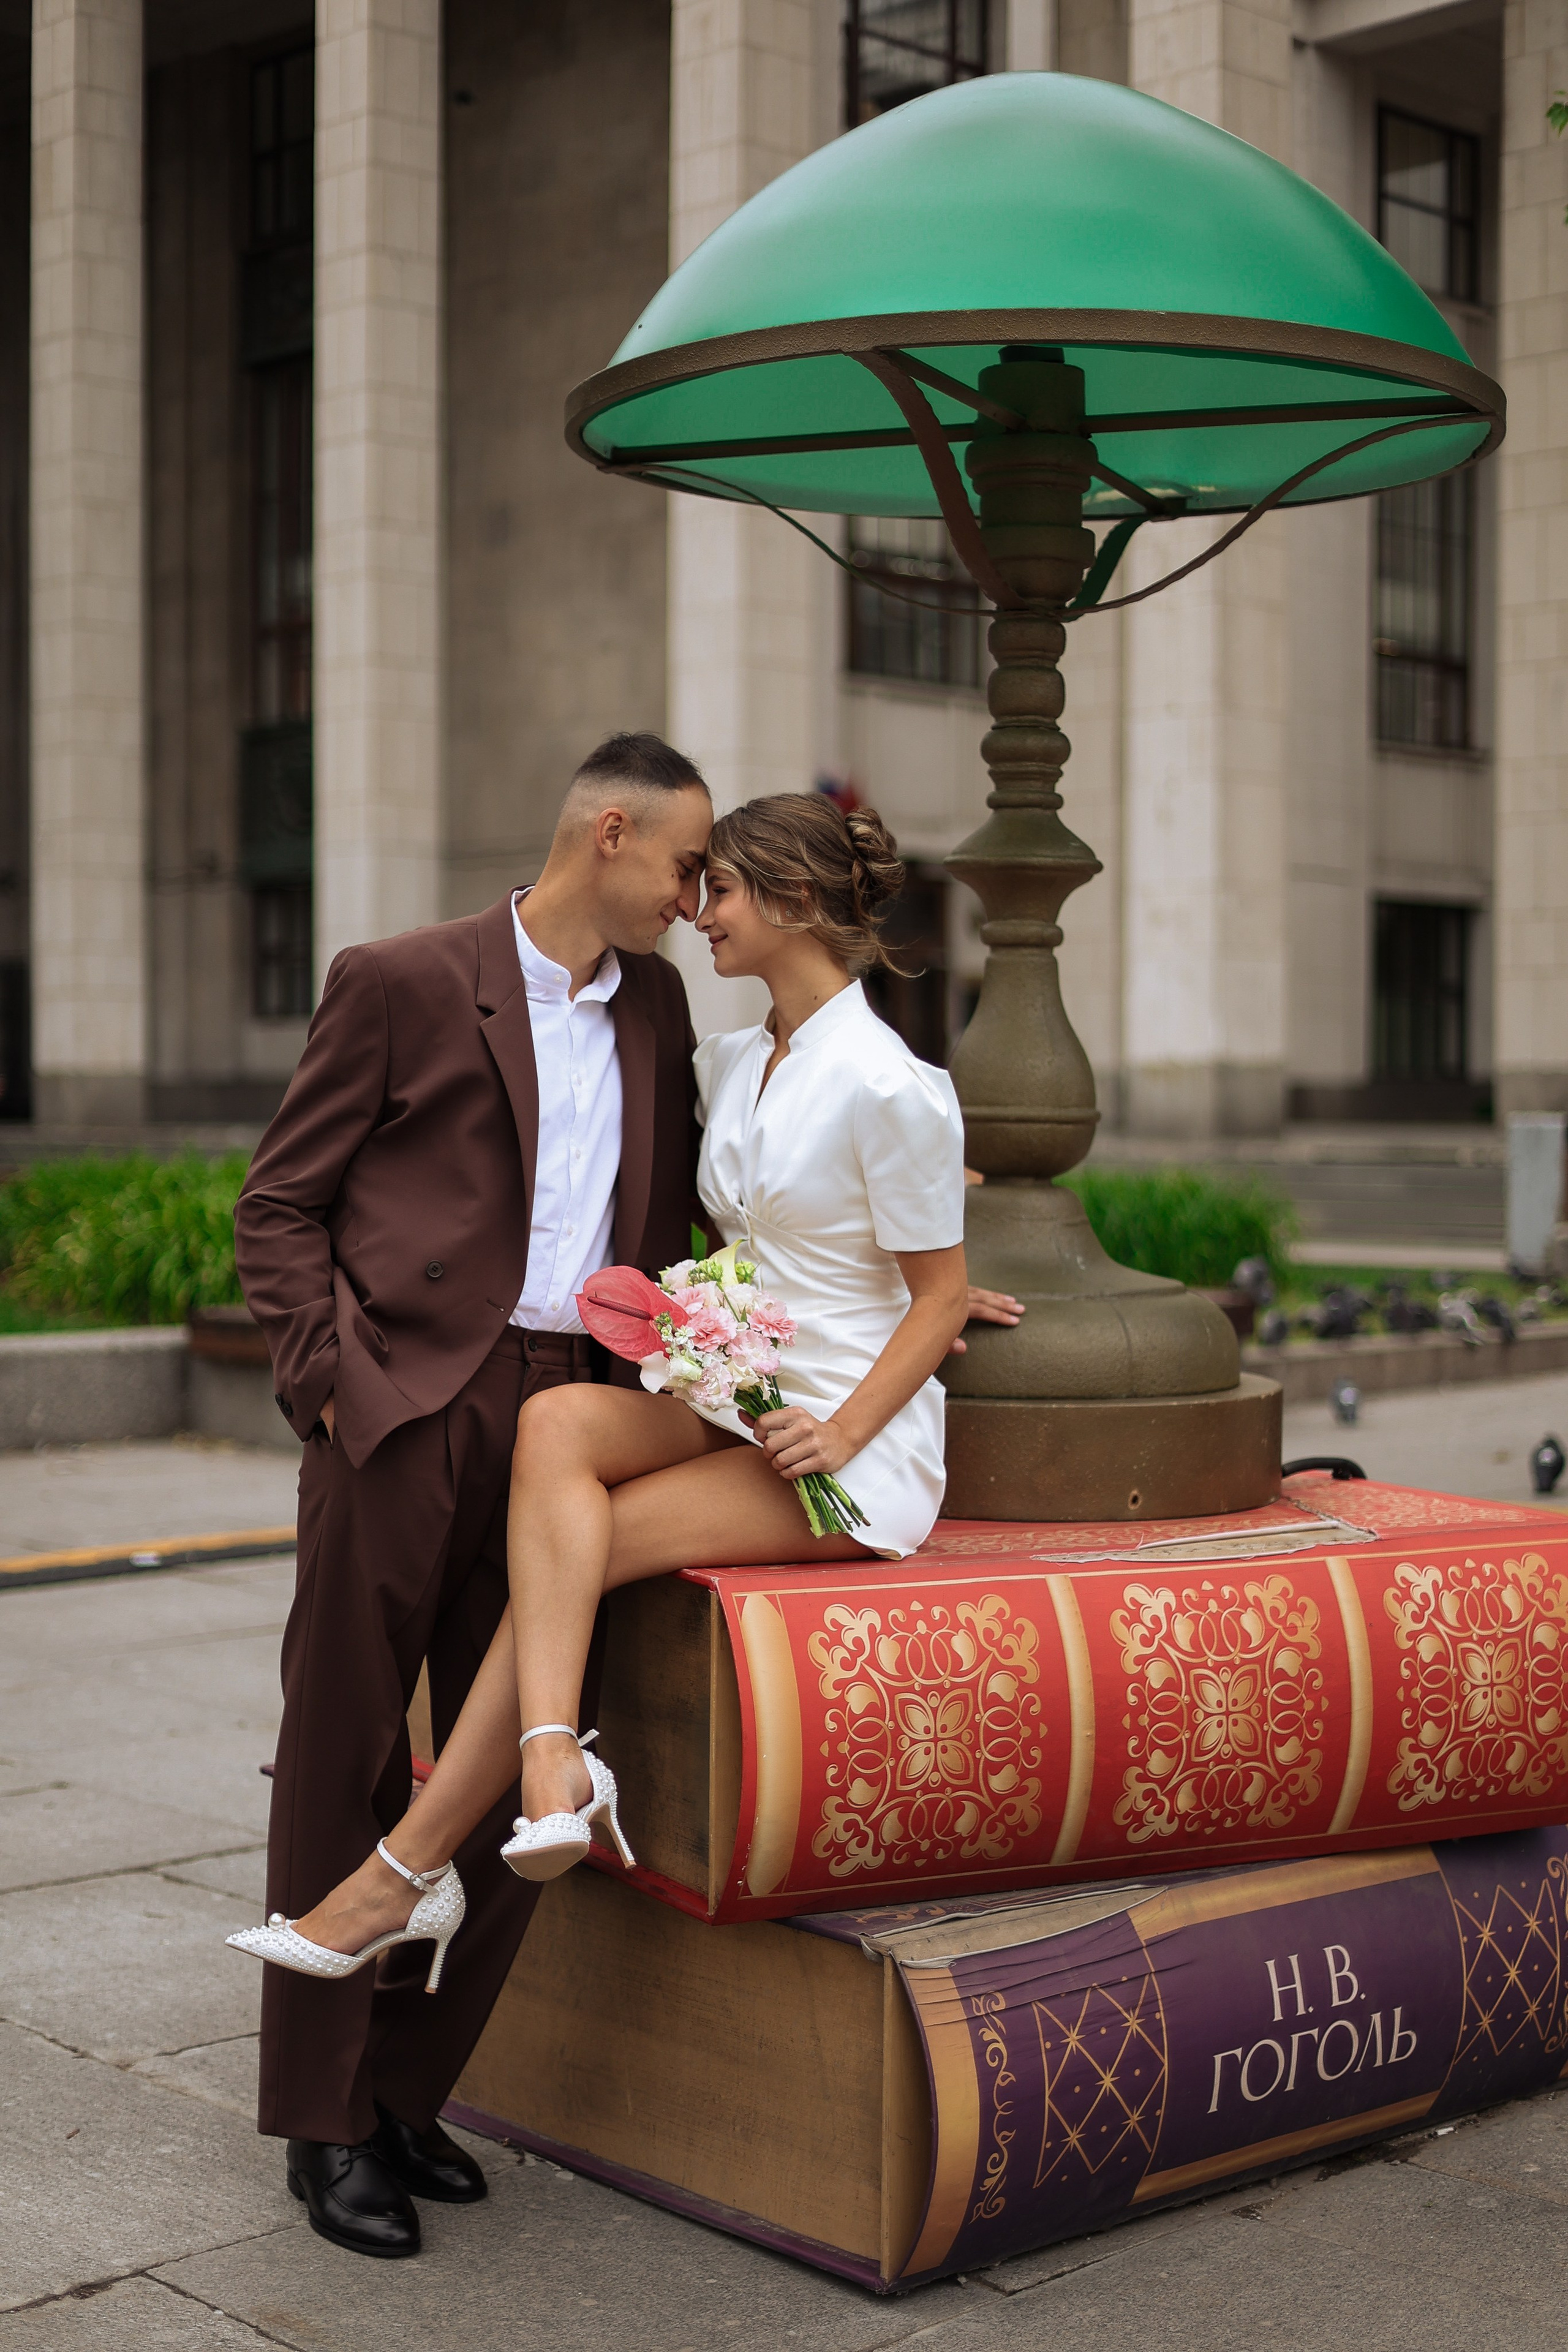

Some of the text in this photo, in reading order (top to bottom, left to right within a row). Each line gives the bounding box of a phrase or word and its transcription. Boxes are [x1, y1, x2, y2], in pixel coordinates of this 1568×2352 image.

[1264, 1944, 1366, 2022] Н. В.
[1207, 2006, 1417, 2114] ГОГОЛЬ
